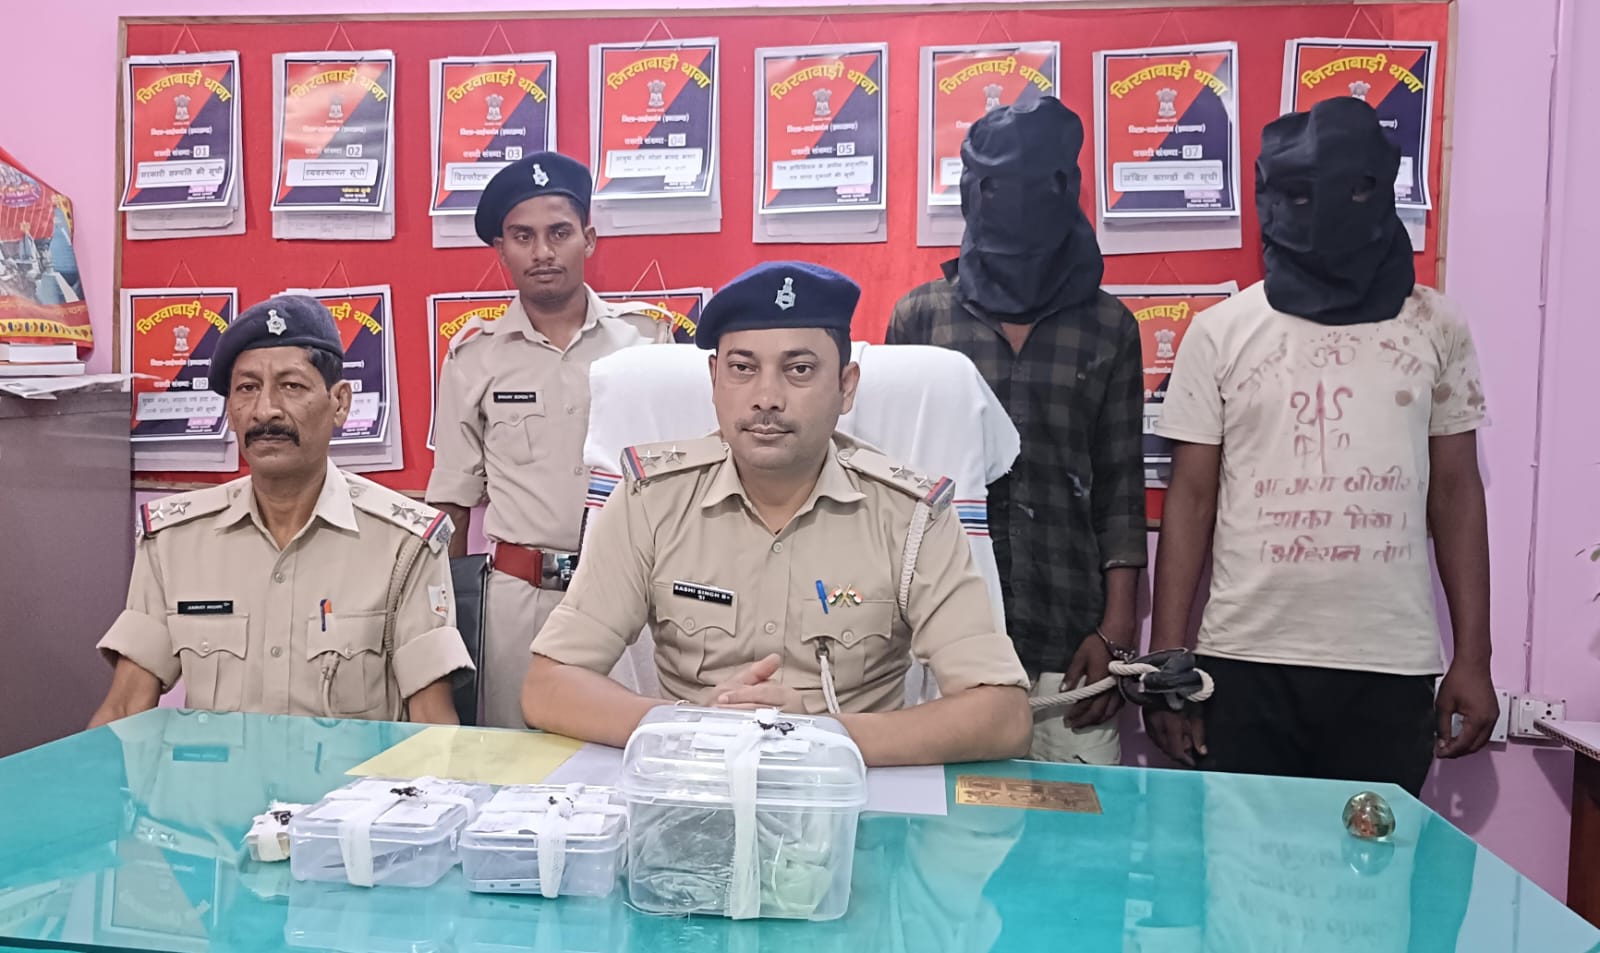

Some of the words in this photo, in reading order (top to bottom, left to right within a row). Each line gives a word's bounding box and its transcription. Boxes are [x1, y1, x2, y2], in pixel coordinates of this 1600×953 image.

[606, 53, 679, 90] जिरवाबाड़ी
[681, 62, 711, 89] थाना
[770, 61, 845, 100] जिरवाबाड़ी
[847, 69, 879, 96] थाना
[938, 56, 1017, 95] जिरवाबाड़ी
[1019, 65, 1052, 92] थाना
[1109, 59, 1191, 100] जिरवाबाड़ी
[1193, 68, 1228, 97] थाना
[1301, 53, 1387, 89] जिरवाबाड़ी
[1389, 63, 1424, 93] थाना
[136, 70, 202, 104] जिरवाबाड़ी
[204, 78, 232, 102] थाना
[290, 67, 357, 98] जिरवाबाड़ी
[359, 76, 388, 102] थाना
[447, 68, 516, 103] जिरवाबाड़ी
[518, 77, 547, 103] थाना
[670, 136, 684, 145] 04
[838, 145, 853, 154] 05
[195, 147, 207, 156] 01
[348, 146, 360, 156] 02
[507, 149, 521, 159] 03
[1184, 147, 1199, 157] 07
[350, 166, 365, 178] सूची
[1183, 171, 1194, 180] की
[1200, 171, 1218, 184] सूची
[136, 300, 201, 335] जिरवाबाड़ी
[203, 308, 229, 334] थाना
[354, 310, 383, 335] थाना
[194, 379, 207, 388] 09
[697, 589, 720, 598] SINGH
